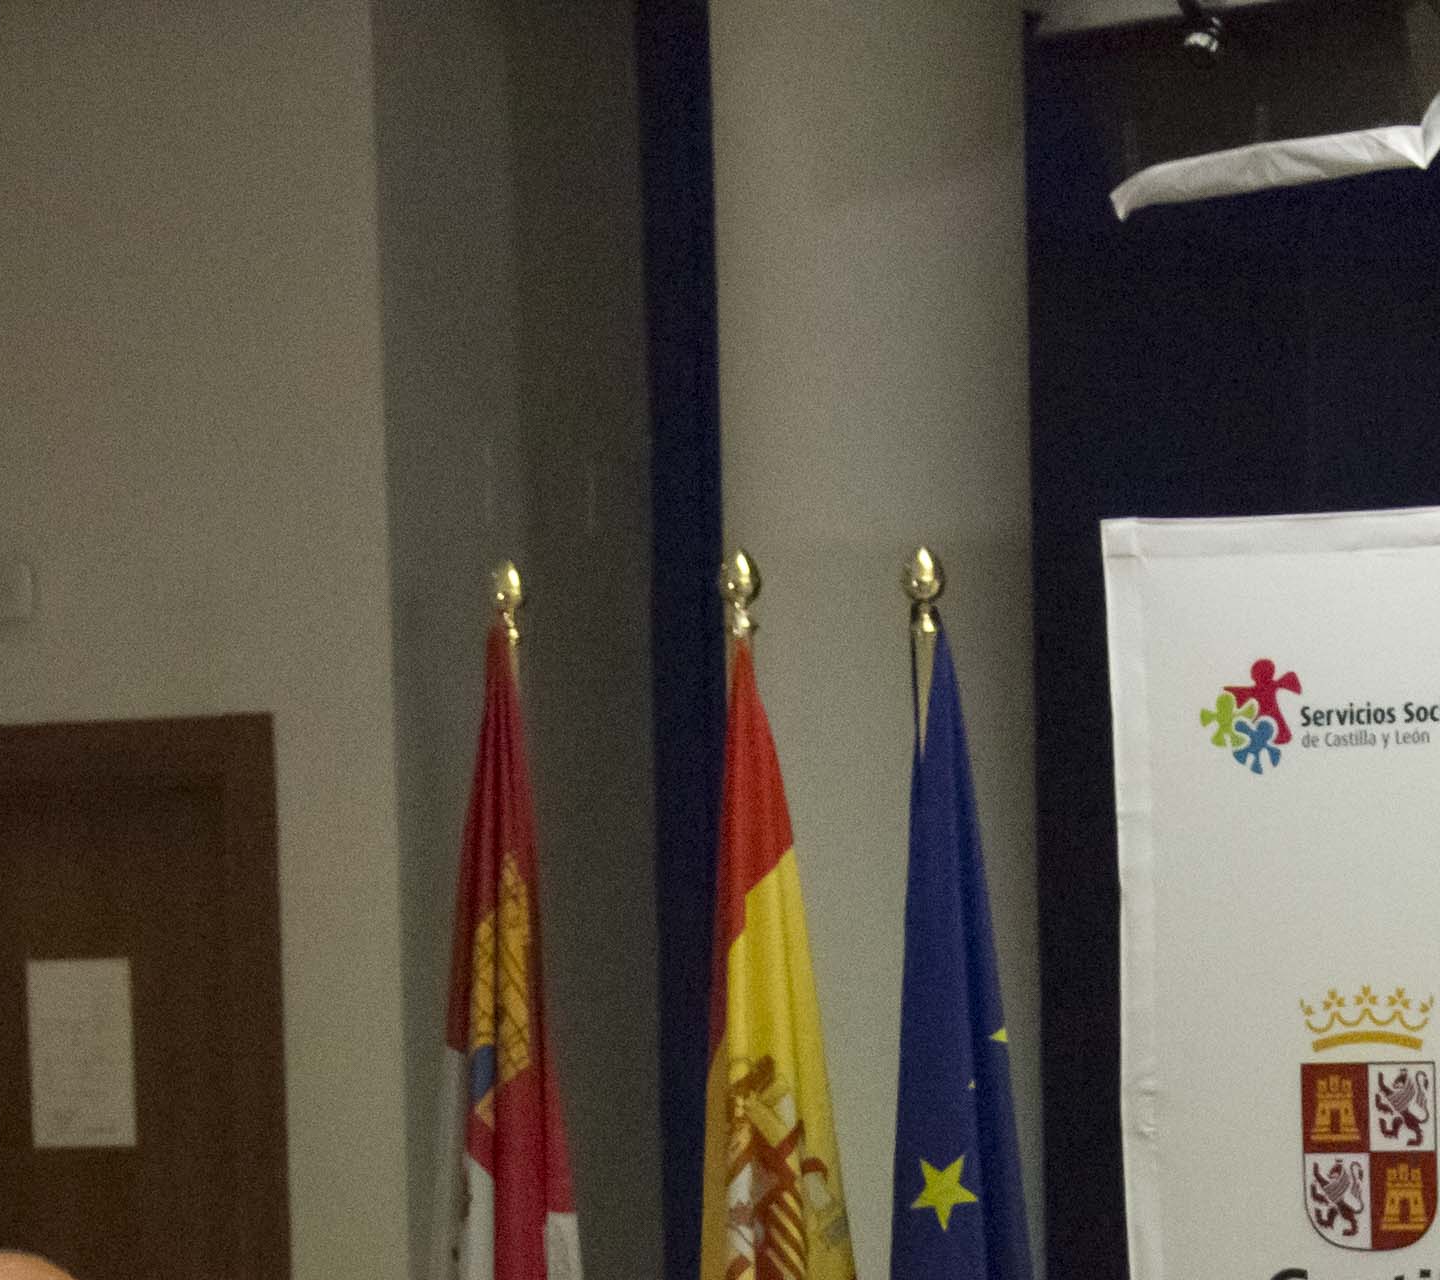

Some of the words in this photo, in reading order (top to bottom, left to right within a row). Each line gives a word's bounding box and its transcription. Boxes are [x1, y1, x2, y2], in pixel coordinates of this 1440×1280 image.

[1300, 702, 1397, 728] Servicios
[1300, 732, 1320, 749] de
[1323, 729, 1378, 748] Castilla
[1381, 733, 1390, 749] y
[1394, 729, 1431, 746] León
